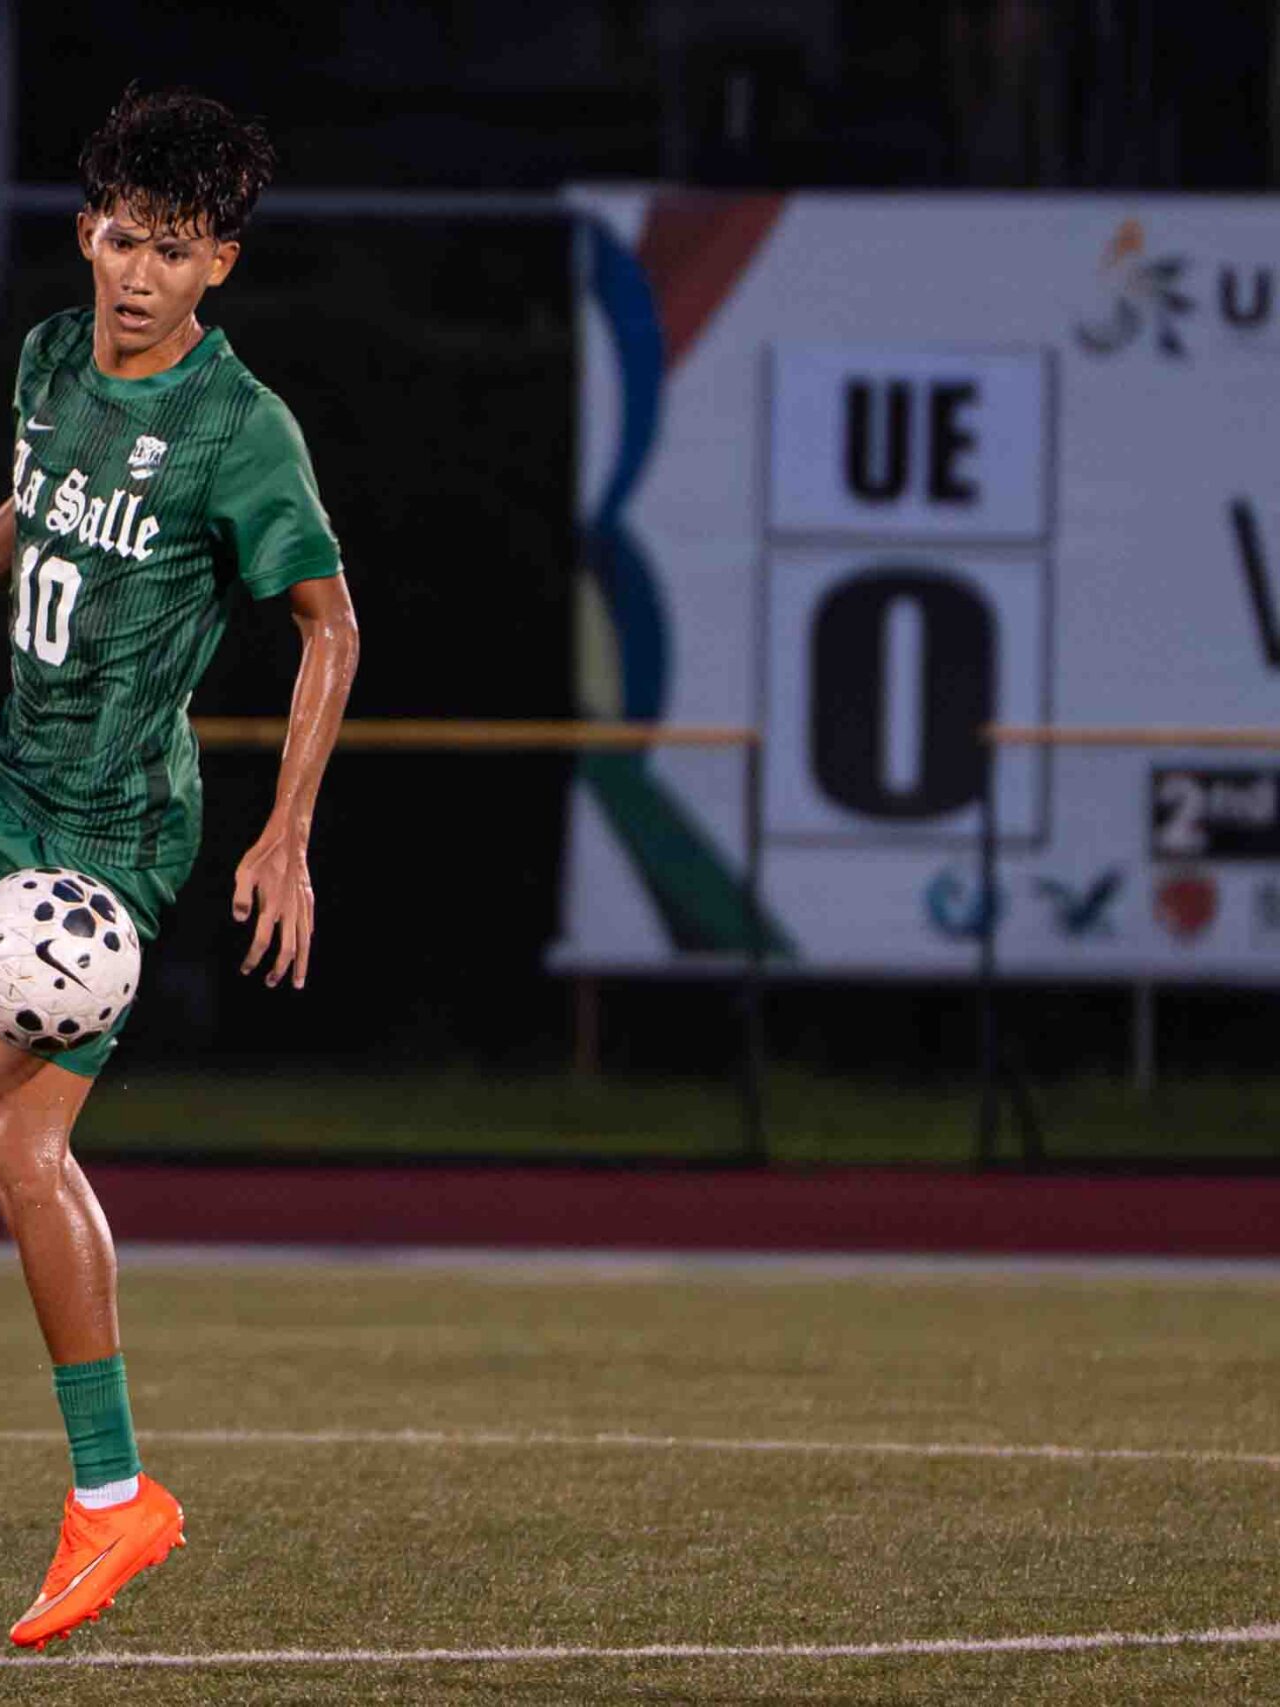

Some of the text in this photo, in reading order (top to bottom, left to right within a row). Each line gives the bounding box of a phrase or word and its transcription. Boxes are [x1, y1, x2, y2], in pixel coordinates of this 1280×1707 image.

[842, 374, 979, 506] UE
[45, 468, 160, 561] Salle
[15, 545, 82, 667] 10
[809, 563, 998, 824] 0
